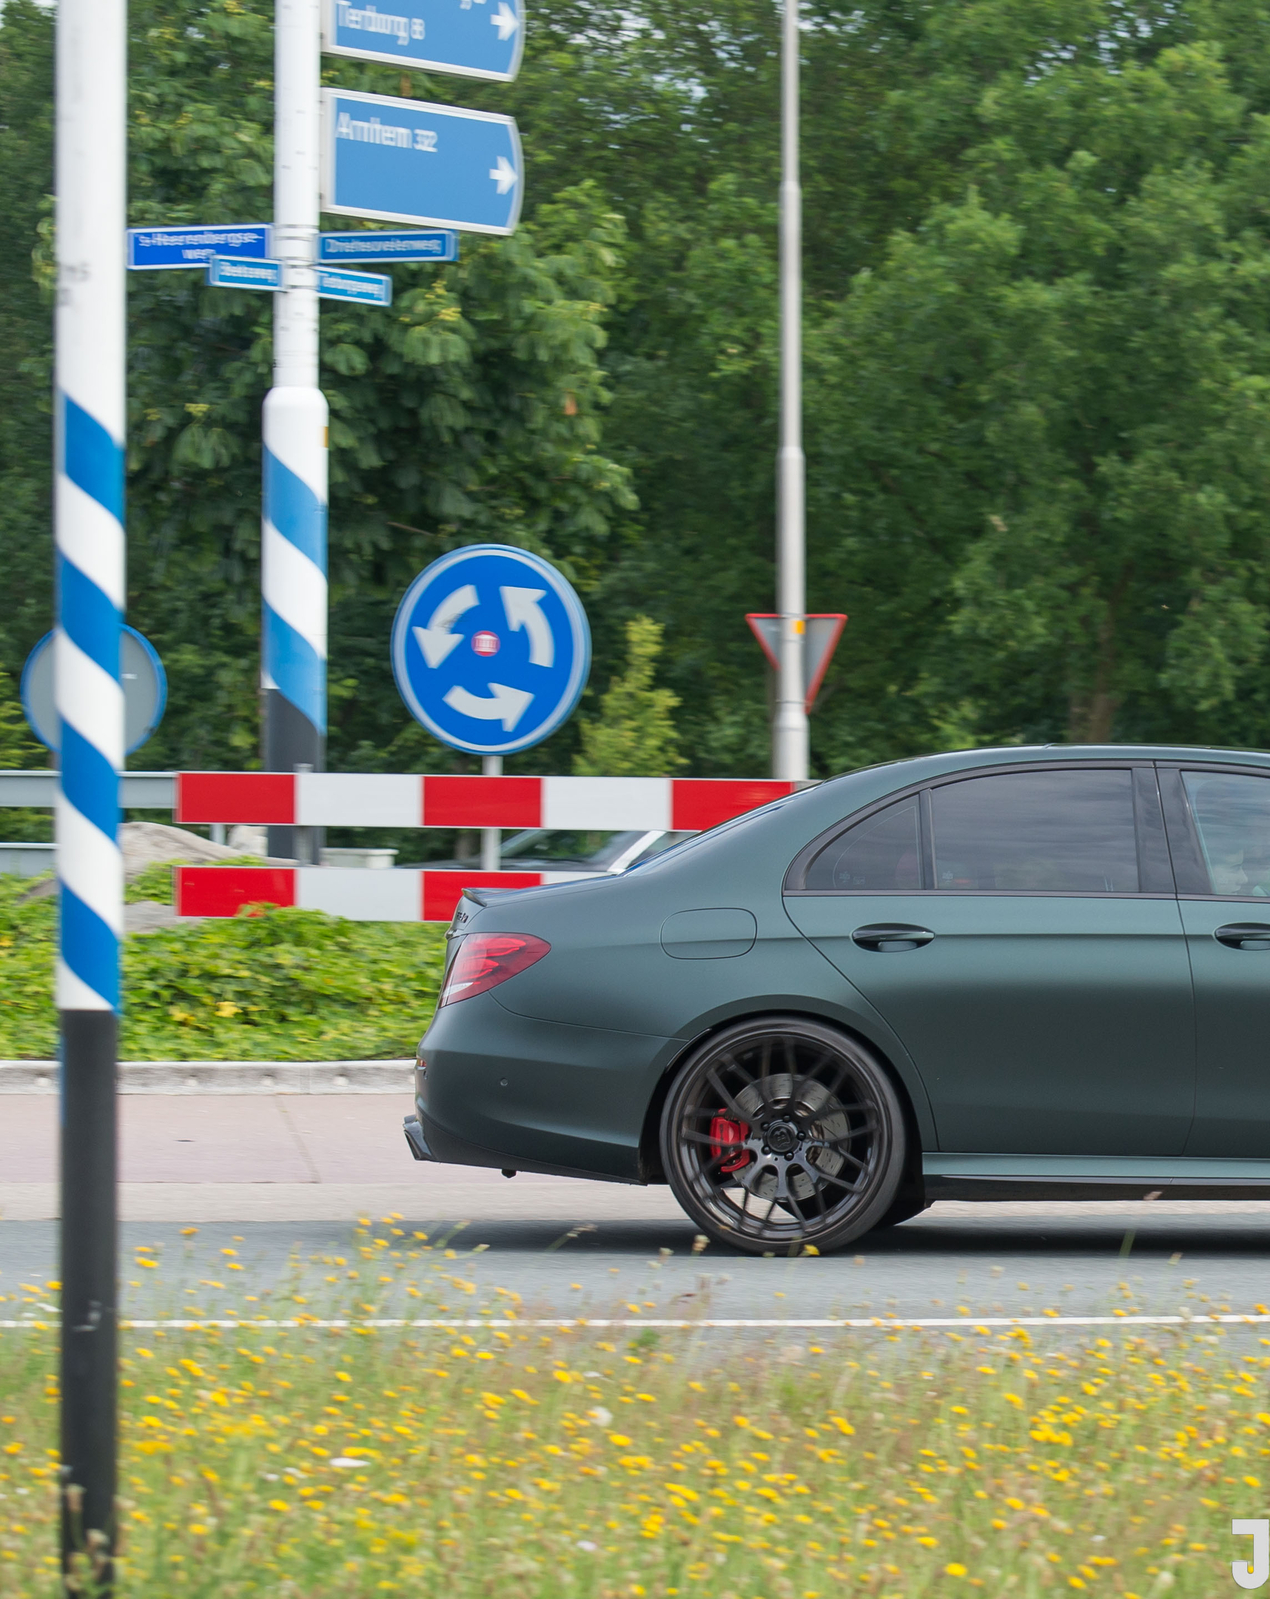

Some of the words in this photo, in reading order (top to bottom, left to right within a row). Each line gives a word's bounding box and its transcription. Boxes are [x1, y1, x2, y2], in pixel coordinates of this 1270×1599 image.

[411, 17, 426, 40] 8
[335, 112, 412, 149] Arnhem
[413, 128, 438, 153] 32
